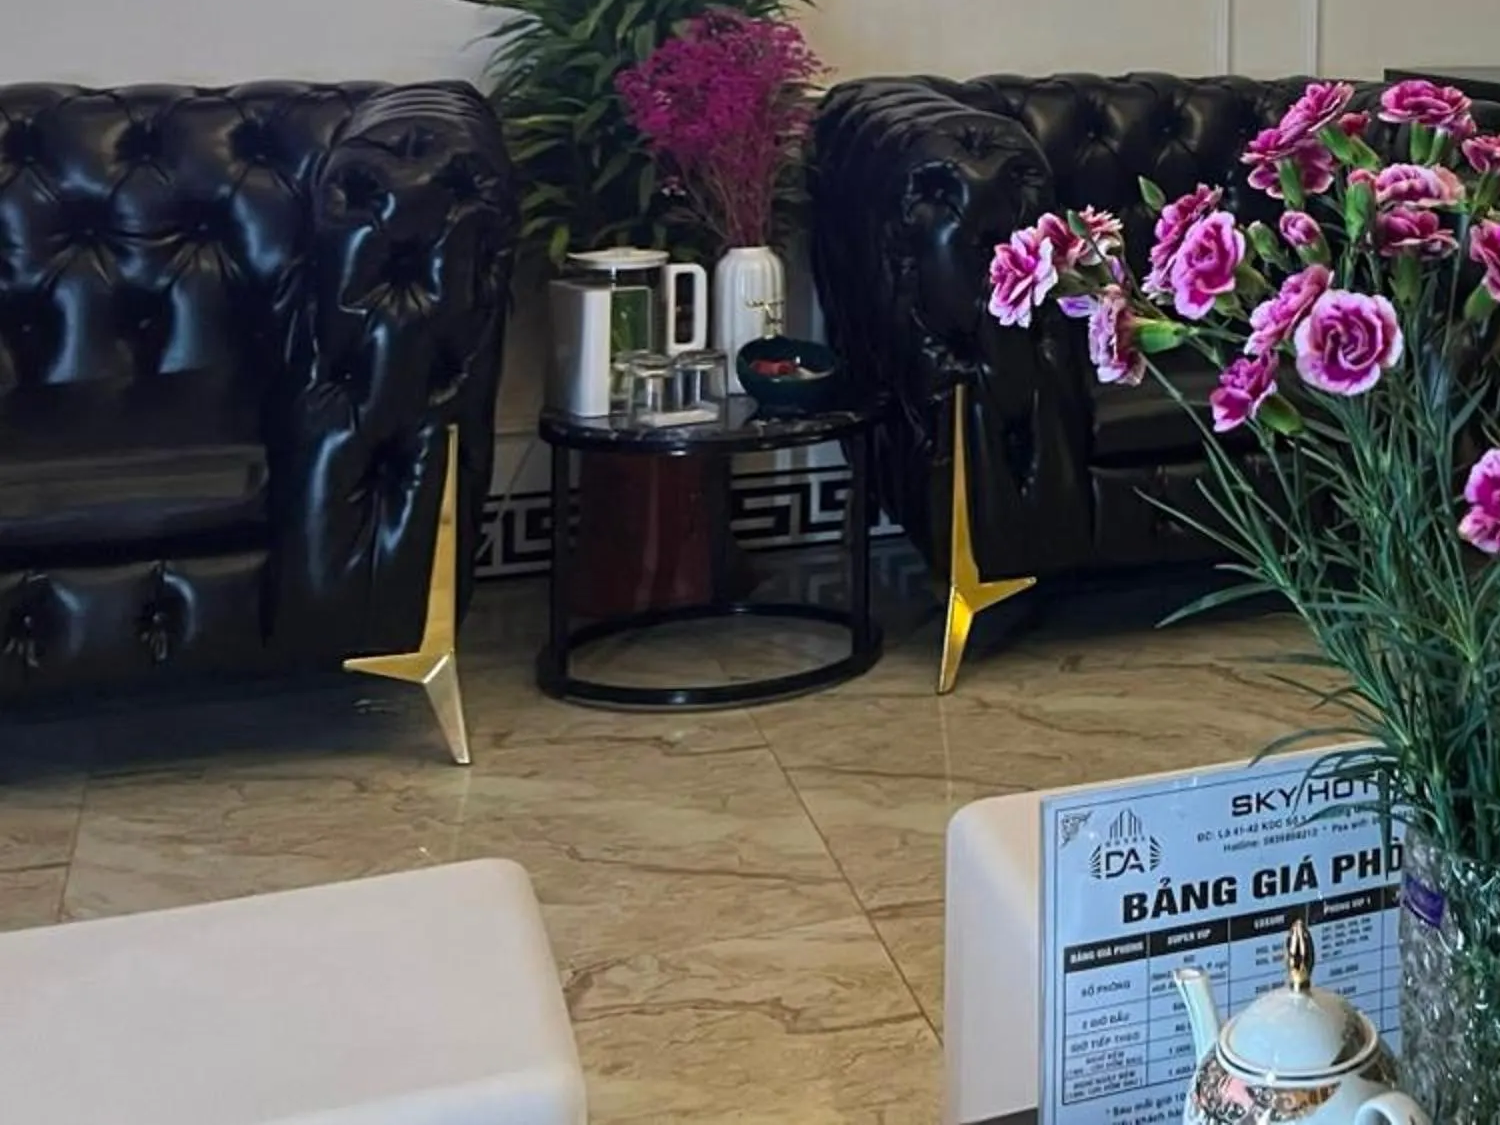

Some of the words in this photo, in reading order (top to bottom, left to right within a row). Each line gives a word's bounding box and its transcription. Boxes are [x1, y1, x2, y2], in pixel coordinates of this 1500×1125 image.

[1232, 786, 1297, 817] SKY
[1123, 876, 1237, 923] BẢNG
[1253, 854, 1318, 899] GIÁ
[1332, 836, 1403, 884] PHÒ
